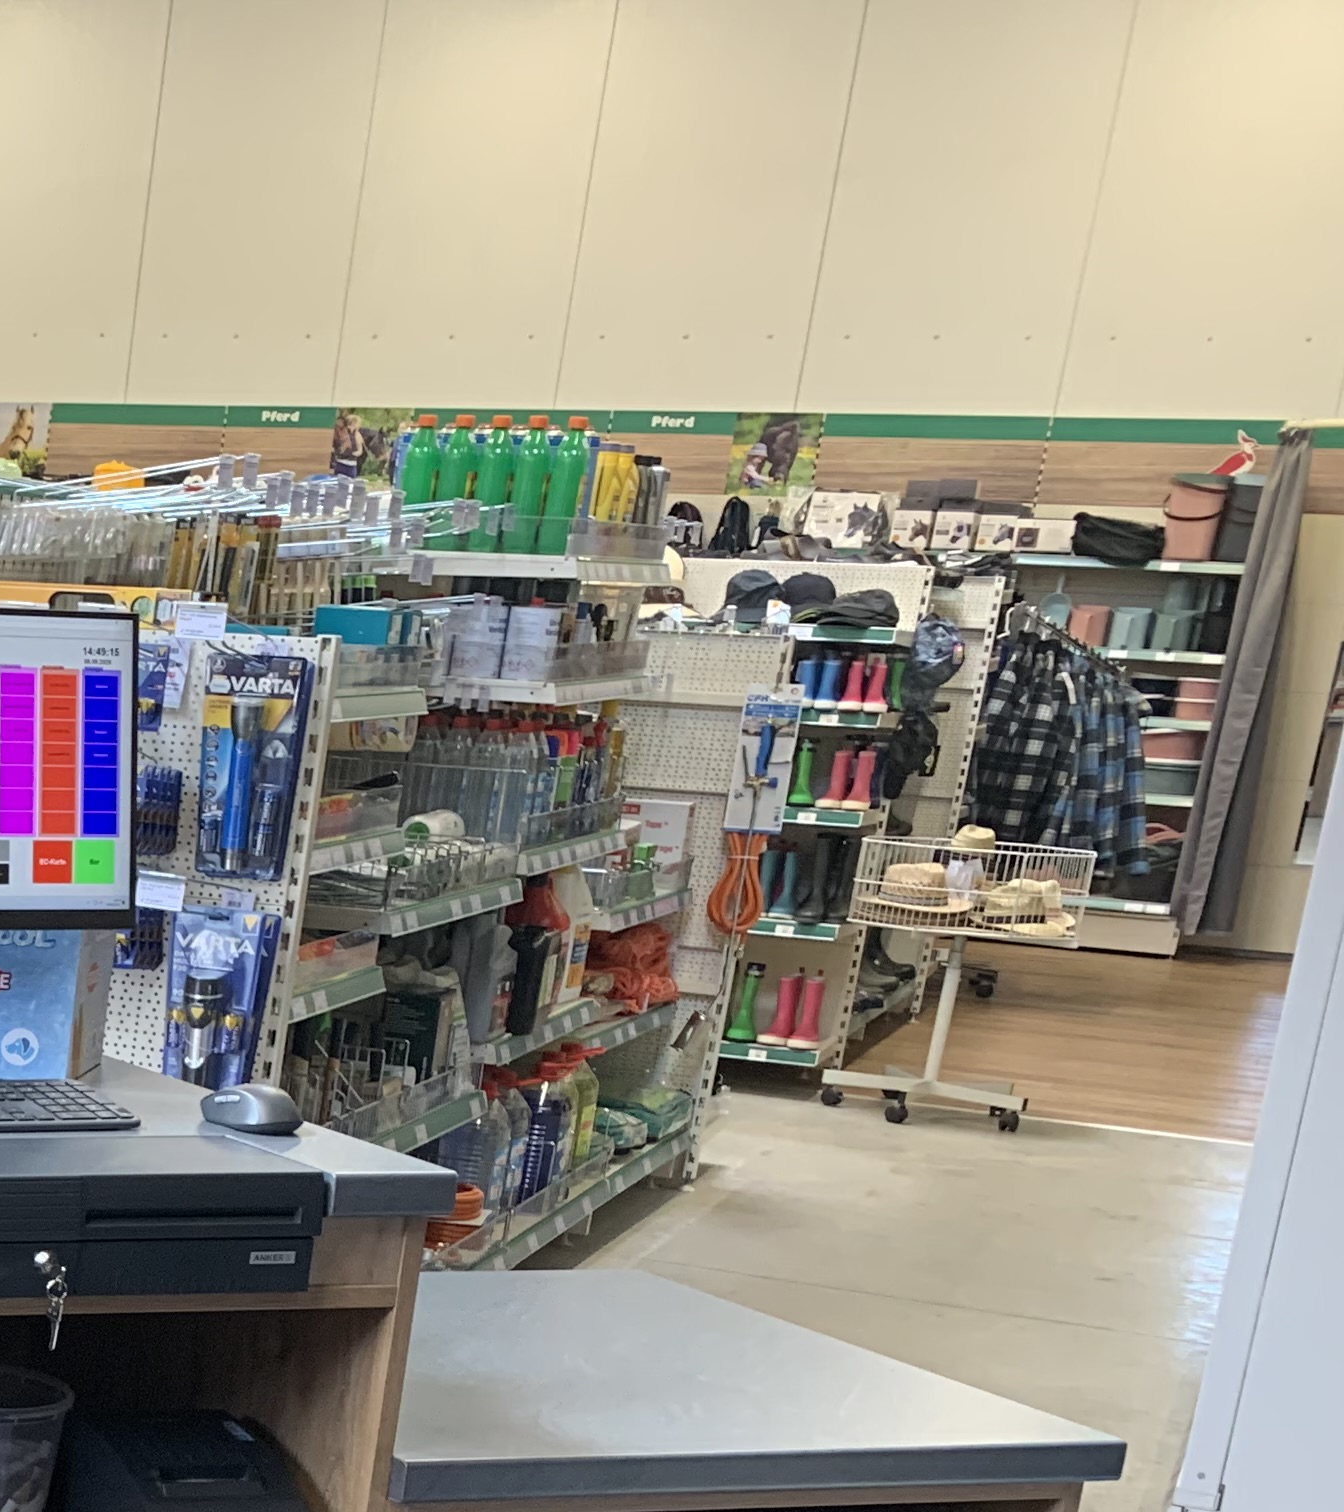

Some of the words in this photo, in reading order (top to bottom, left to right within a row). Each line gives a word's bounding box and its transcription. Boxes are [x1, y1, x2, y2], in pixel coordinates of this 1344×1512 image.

[260, 409, 300, 423] Pferd
[650, 415, 695, 430] Pferd
[83, 646, 120, 657] 14:49:15
[230, 675, 296, 696] VARTA
[175, 930, 256, 956] VARTA
